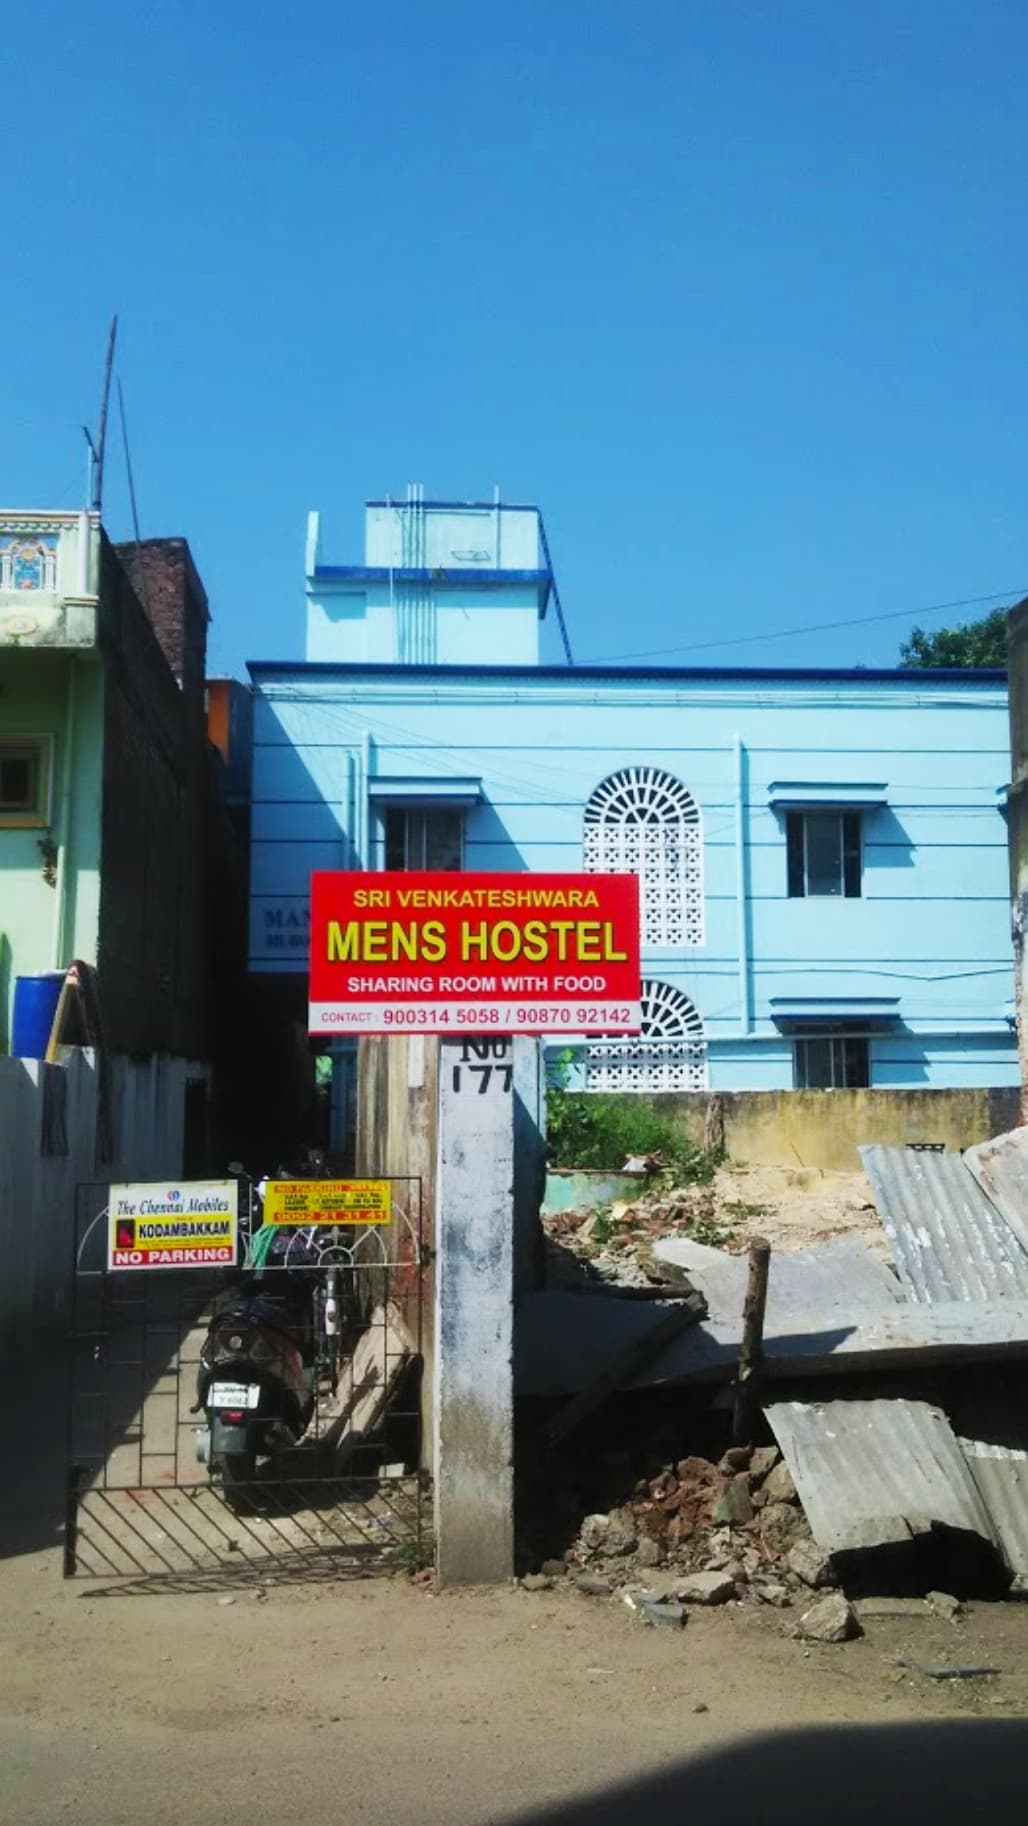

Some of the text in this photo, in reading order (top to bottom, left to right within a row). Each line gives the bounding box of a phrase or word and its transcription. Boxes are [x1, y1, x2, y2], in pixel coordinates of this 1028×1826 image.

[353, 889, 599, 908] SRI VENKATESHWARA
[327, 920, 628, 962] MENS HOSTEL
[347, 976, 606, 993] SHARING ROOM WITH FOOD
[383, 1008, 450, 1025] 900314
[456, 1008, 499, 1024] 5058
[516, 1008, 570, 1024] 90870
[577, 1008, 631, 1023] 92142
[453, 1065, 513, 1094] 177
[117, 1196, 229, 1215] The Chennai Mobiles
[139, 1221, 230, 1239] KODAMBAKKAM
[115, 1247, 230, 1265] NO PARKING
